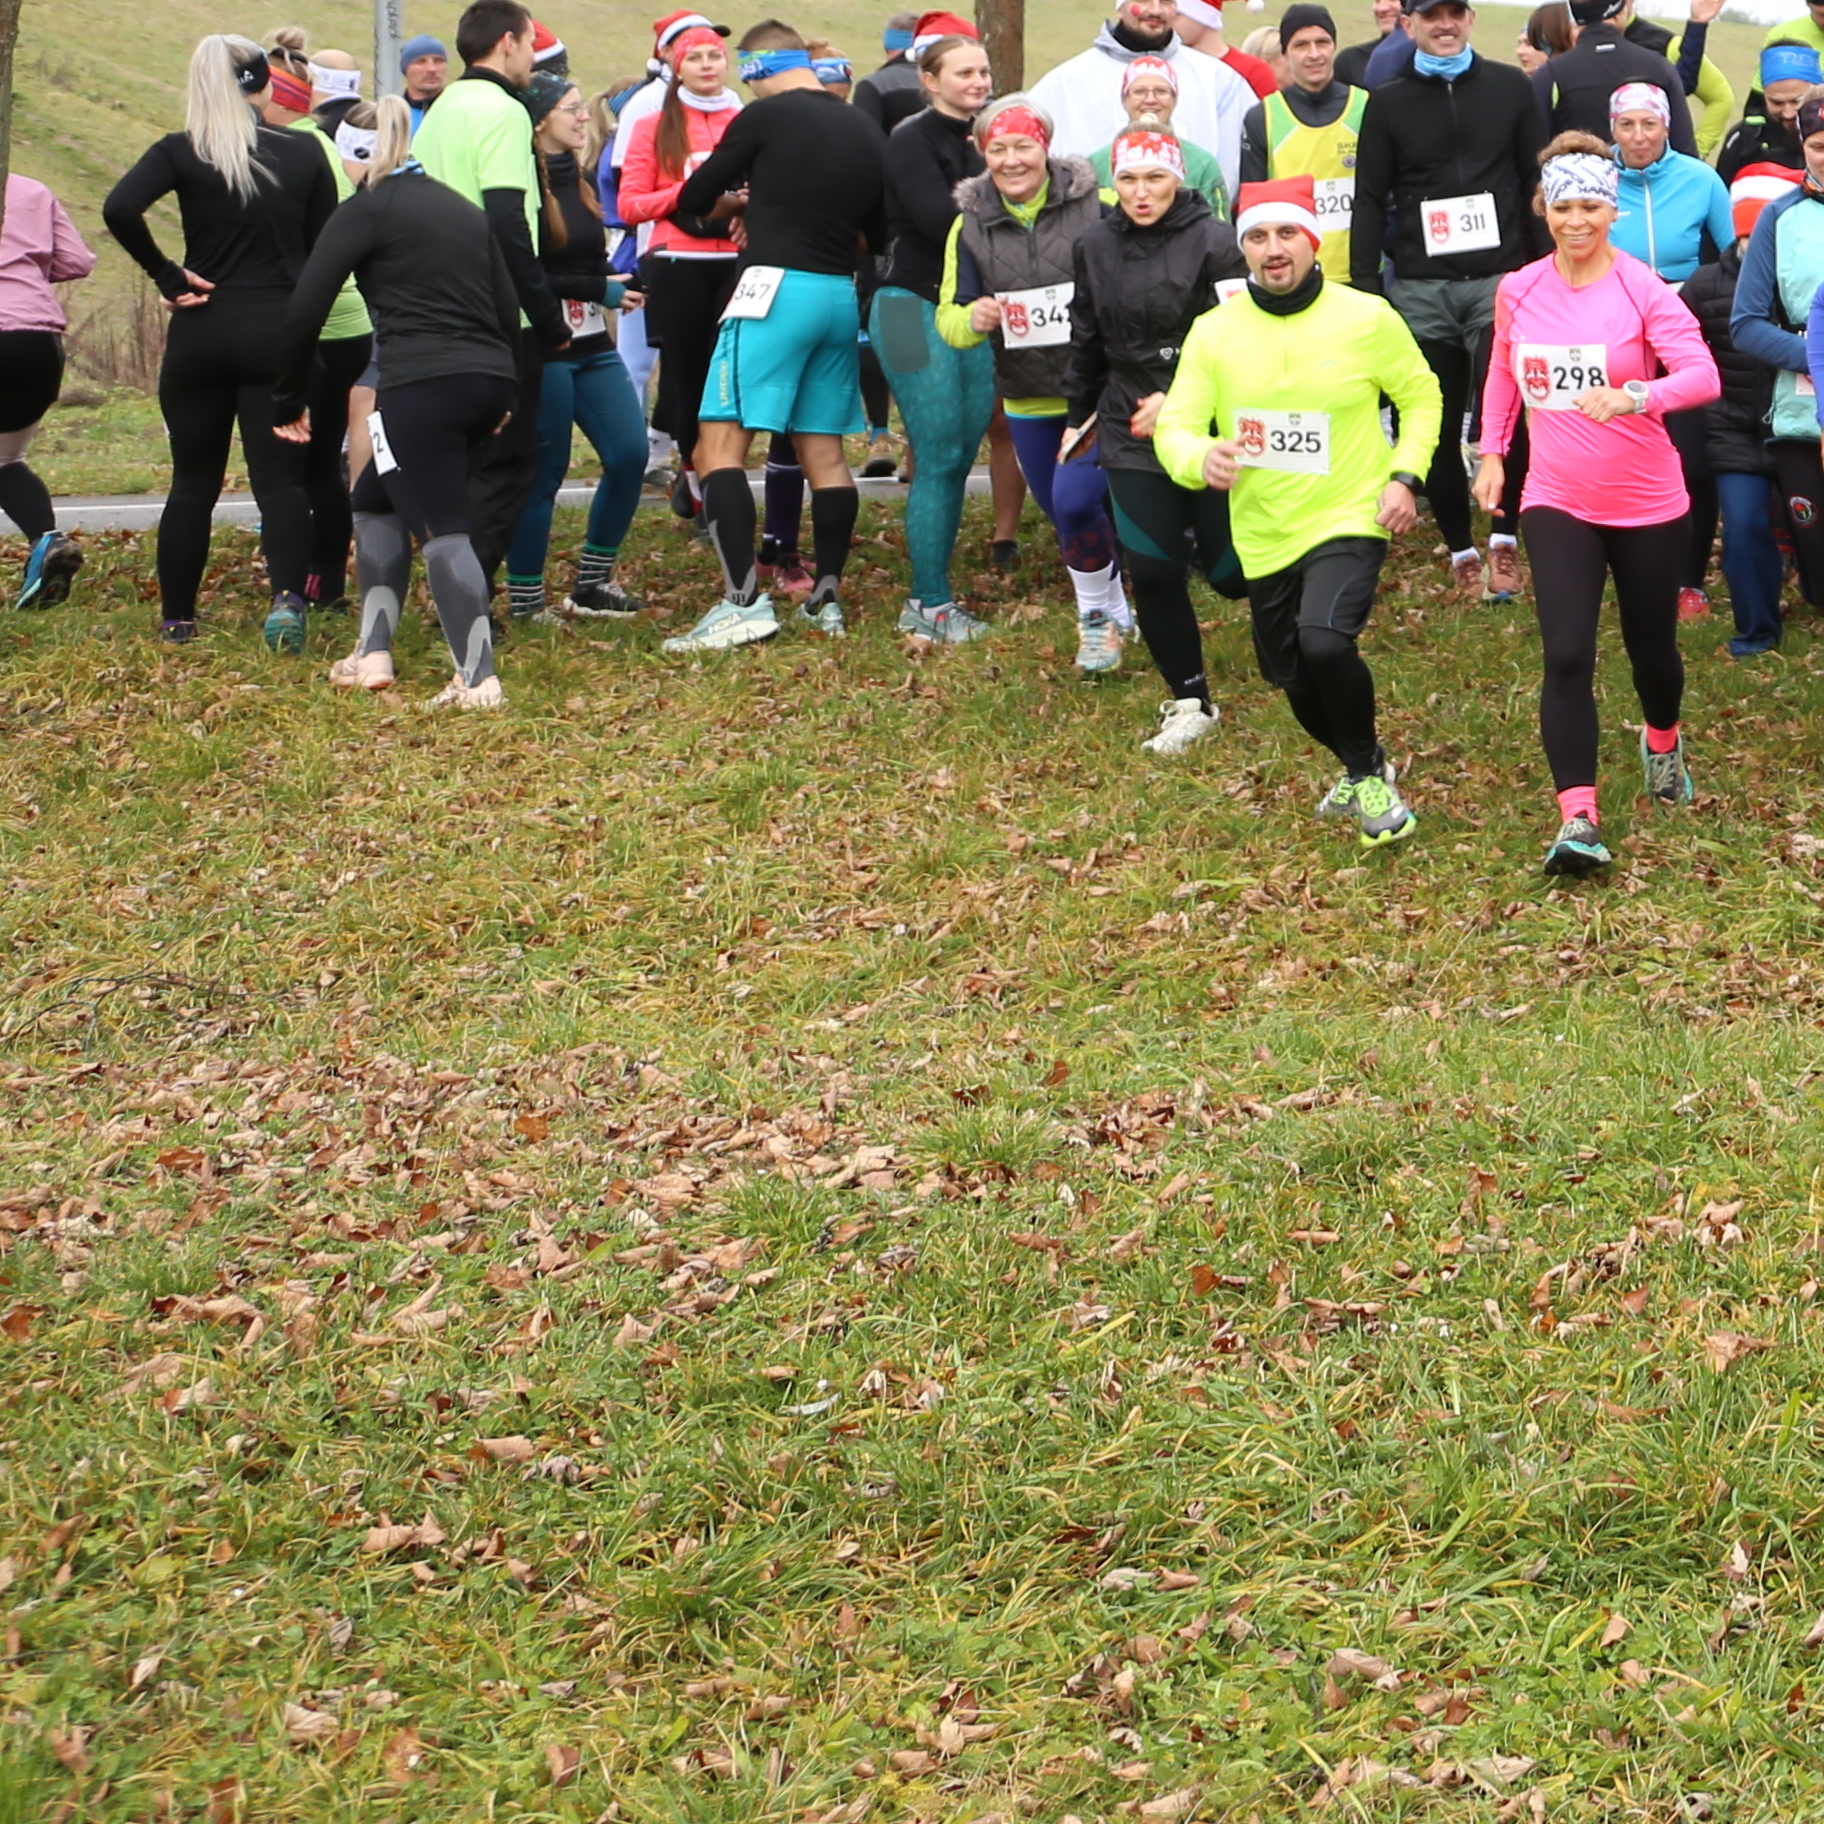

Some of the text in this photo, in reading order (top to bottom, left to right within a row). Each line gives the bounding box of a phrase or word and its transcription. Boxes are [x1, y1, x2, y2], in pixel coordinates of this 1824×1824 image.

[1315, 193, 1352, 216] 320
[1460, 213, 1487, 233] 311
[734, 283, 772, 301] 347
[1553, 365, 1606, 390] 298
[1270, 429, 1322, 454] 325
